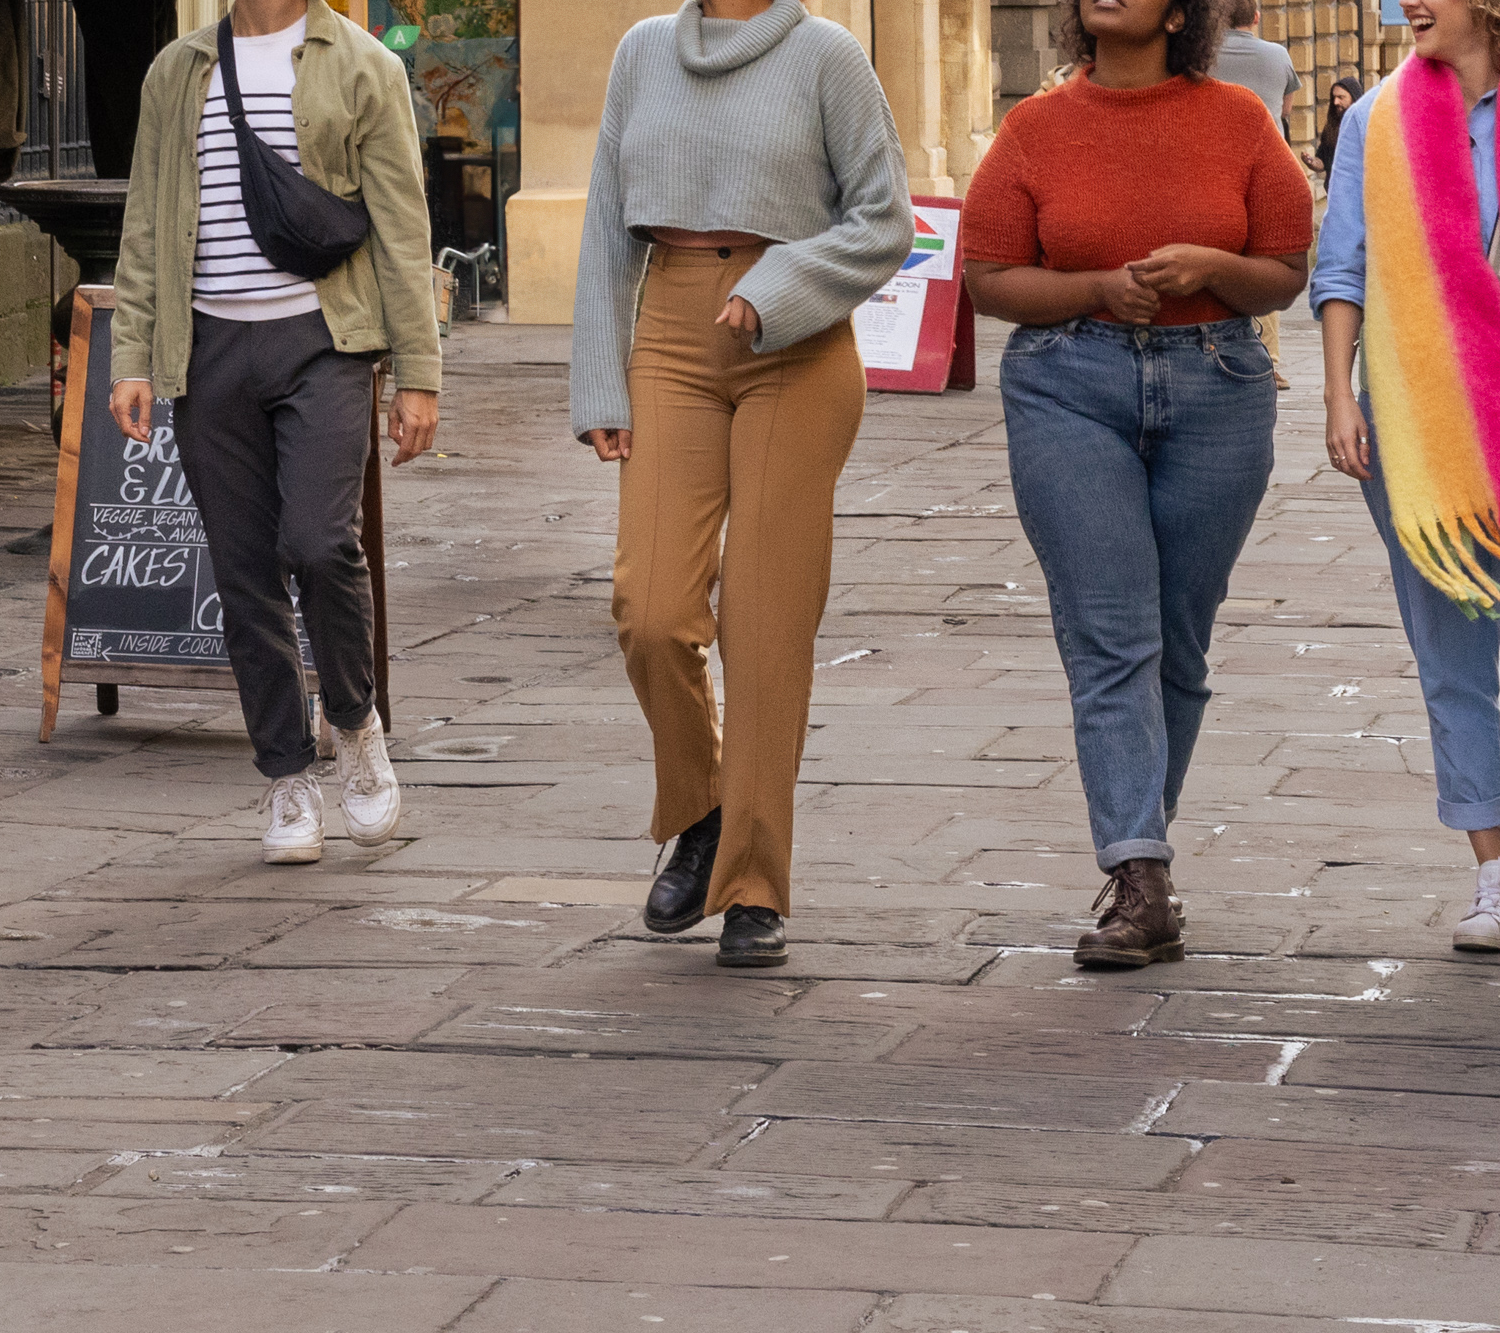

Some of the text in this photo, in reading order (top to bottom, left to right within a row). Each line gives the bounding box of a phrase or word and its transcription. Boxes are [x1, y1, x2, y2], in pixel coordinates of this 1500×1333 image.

[119, 464, 148, 503] &
[152, 510, 197, 526] VEGAN
[81, 545, 190, 588] CAKES
[118, 634, 173, 654] INSIDE
[177, 635, 223, 655] CORN
